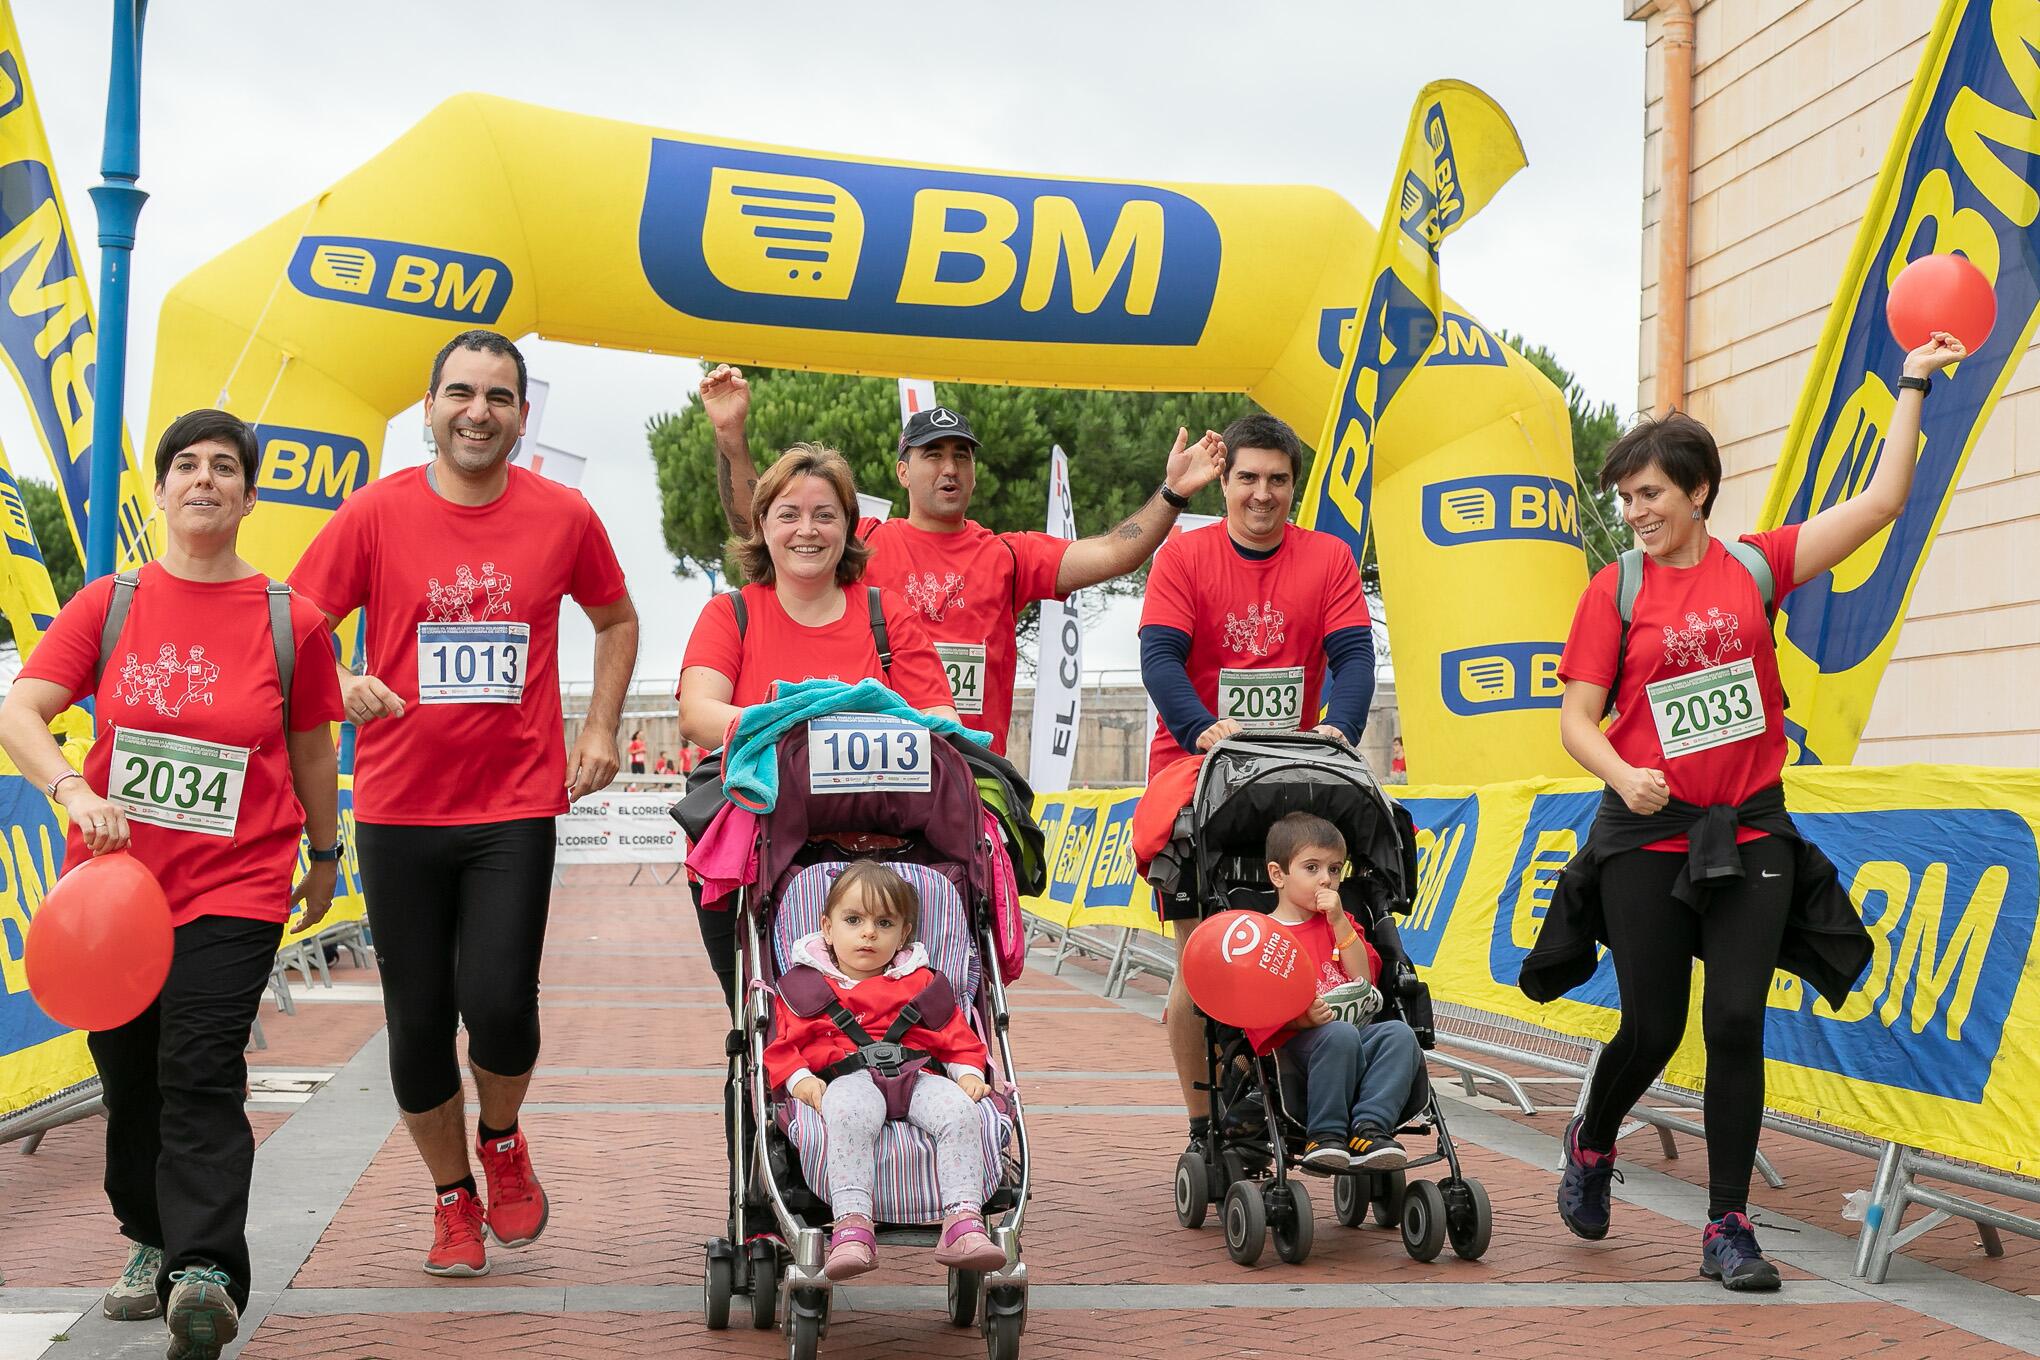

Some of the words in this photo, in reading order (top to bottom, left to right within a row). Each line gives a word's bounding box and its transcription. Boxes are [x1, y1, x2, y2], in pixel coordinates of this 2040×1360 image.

[1435, 157, 1461, 220] BM
[895, 188, 1164, 316] BM
[386, 254, 497, 315] BM
[258, 440, 361, 498] BM
[1510, 485, 1578, 538] BM
[1060, 484, 1079, 689] COREO
[433, 645, 517, 683] 1013
[946, 664, 977, 697] 34
[1052, 699, 1076, 757] EL
[1229, 686, 1297, 718] 2033
[1665, 683, 1753, 738] 2033
[824, 732, 919, 770] 1013
[122, 756, 228, 812] 2034
[568, 807, 607, 815] ORREO
[565, 837, 608, 845] CORREO
[619, 836, 631, 844] EL
[632, 836, 673, 845] CORREO
[1259, 932, 1281, 970] retina
[1269, 939, 1291, 976] BIZKAIA
[1812, 860, 2009, 1041] BM
